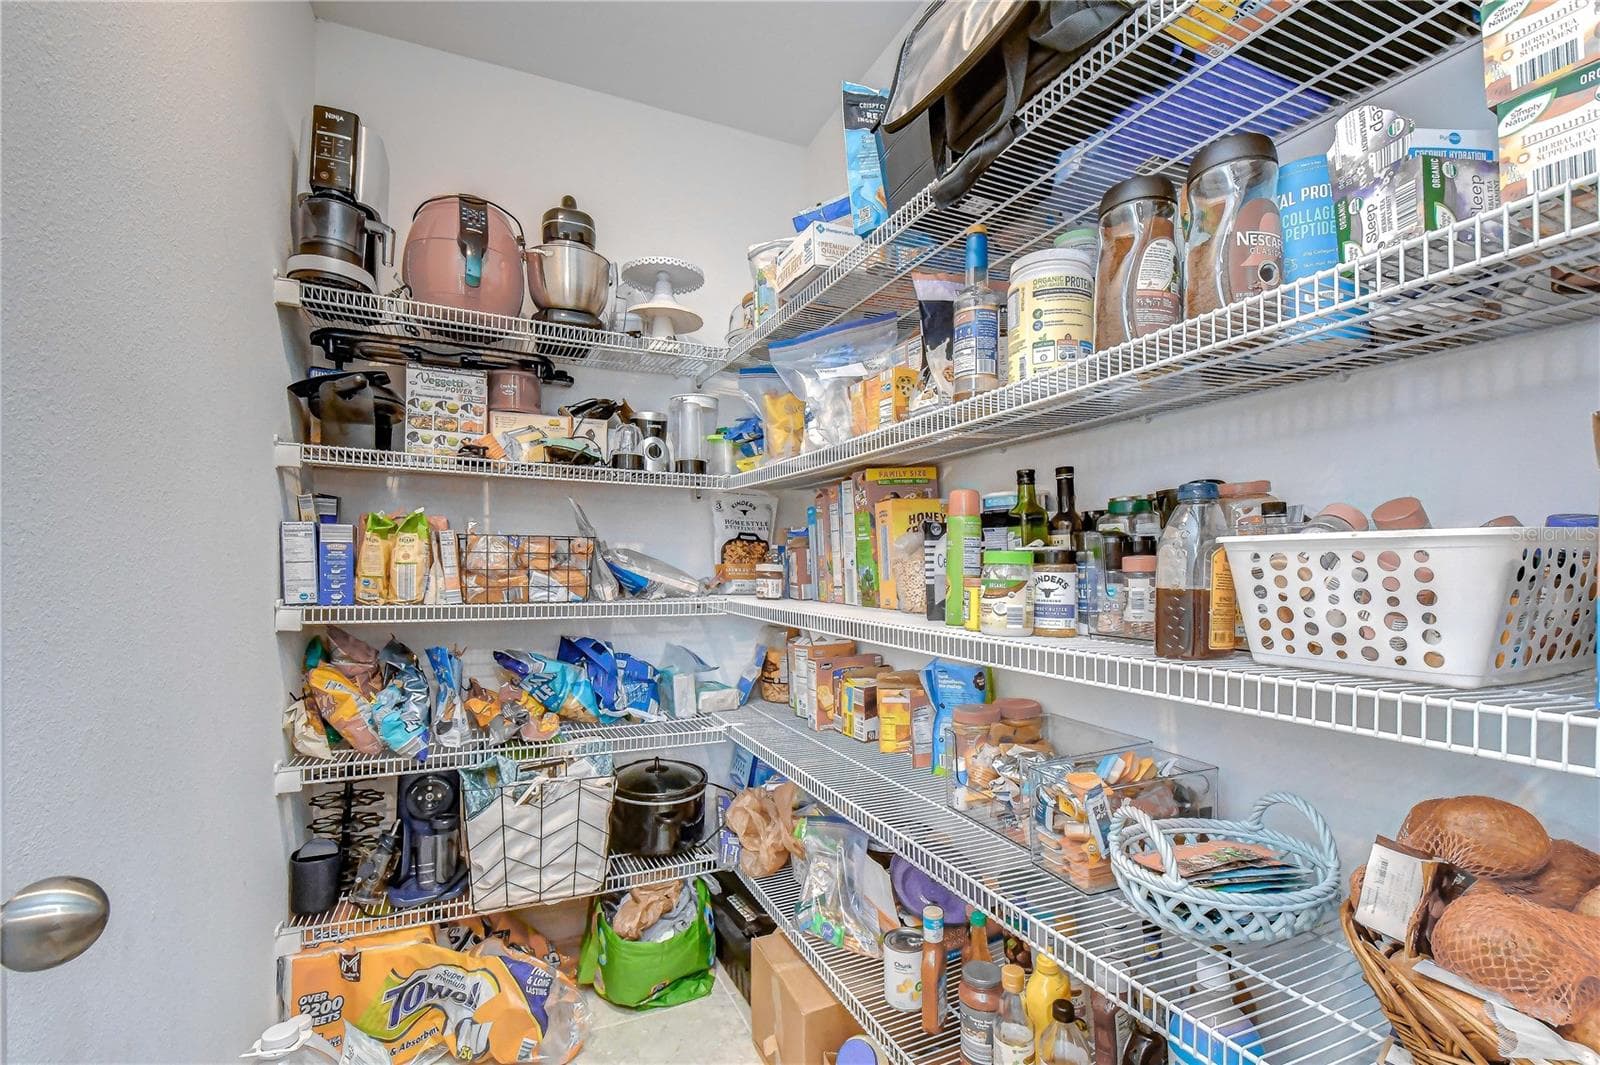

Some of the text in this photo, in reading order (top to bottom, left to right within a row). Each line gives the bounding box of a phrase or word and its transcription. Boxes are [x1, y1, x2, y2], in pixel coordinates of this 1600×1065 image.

[1494, 0, 1525, 19] Simply
[1488, 10, 1519, 28] Nature
[1520, 24, 1580, 58] SUPPLEMENT
[1521, 18, 1578, 50] HERBAL TEA
[325, 111, 344, 122] NINJA
[1505, 112, 1536, 128] Nature
[1510, 103, 1543, 120] Simply
[1521, 109, 1600, 147] Immunit
[1538, 127, 1596, 153] HERBAL TEA
[1449, 151, 1487, 161] HYDRATION
[1431, 158, 1441, 189] ORGANIC
[1282, 205, 1335, 229] COLLAGE
[1338, 200, 1348, 231] ORGANIC
[1365, 203, 1378, 244] Sleep
[1285, 220, 1337, 246] PEPTIDE
[821, 242, 850, 251] PREMIUM
[821, 248, 847, 257] QUALIT
[415, 371, 464, 388] Veggetti
[445, 387, 473, 395] POWER
[724, 519, 768, 527] HOMESTYLE
[908, 511, 947, 525] HONEY
[434, 973, 467, 991] Premium
[442, 969, 465, 981] Super
[300, 992, 328, 1006] OVER
[526, 986, 548, 996] LASTING
[300, 996, 344, 1018] 2200
[313, 1012, 341, 1026] EETS
[389, 1047, 398, 1057] &
